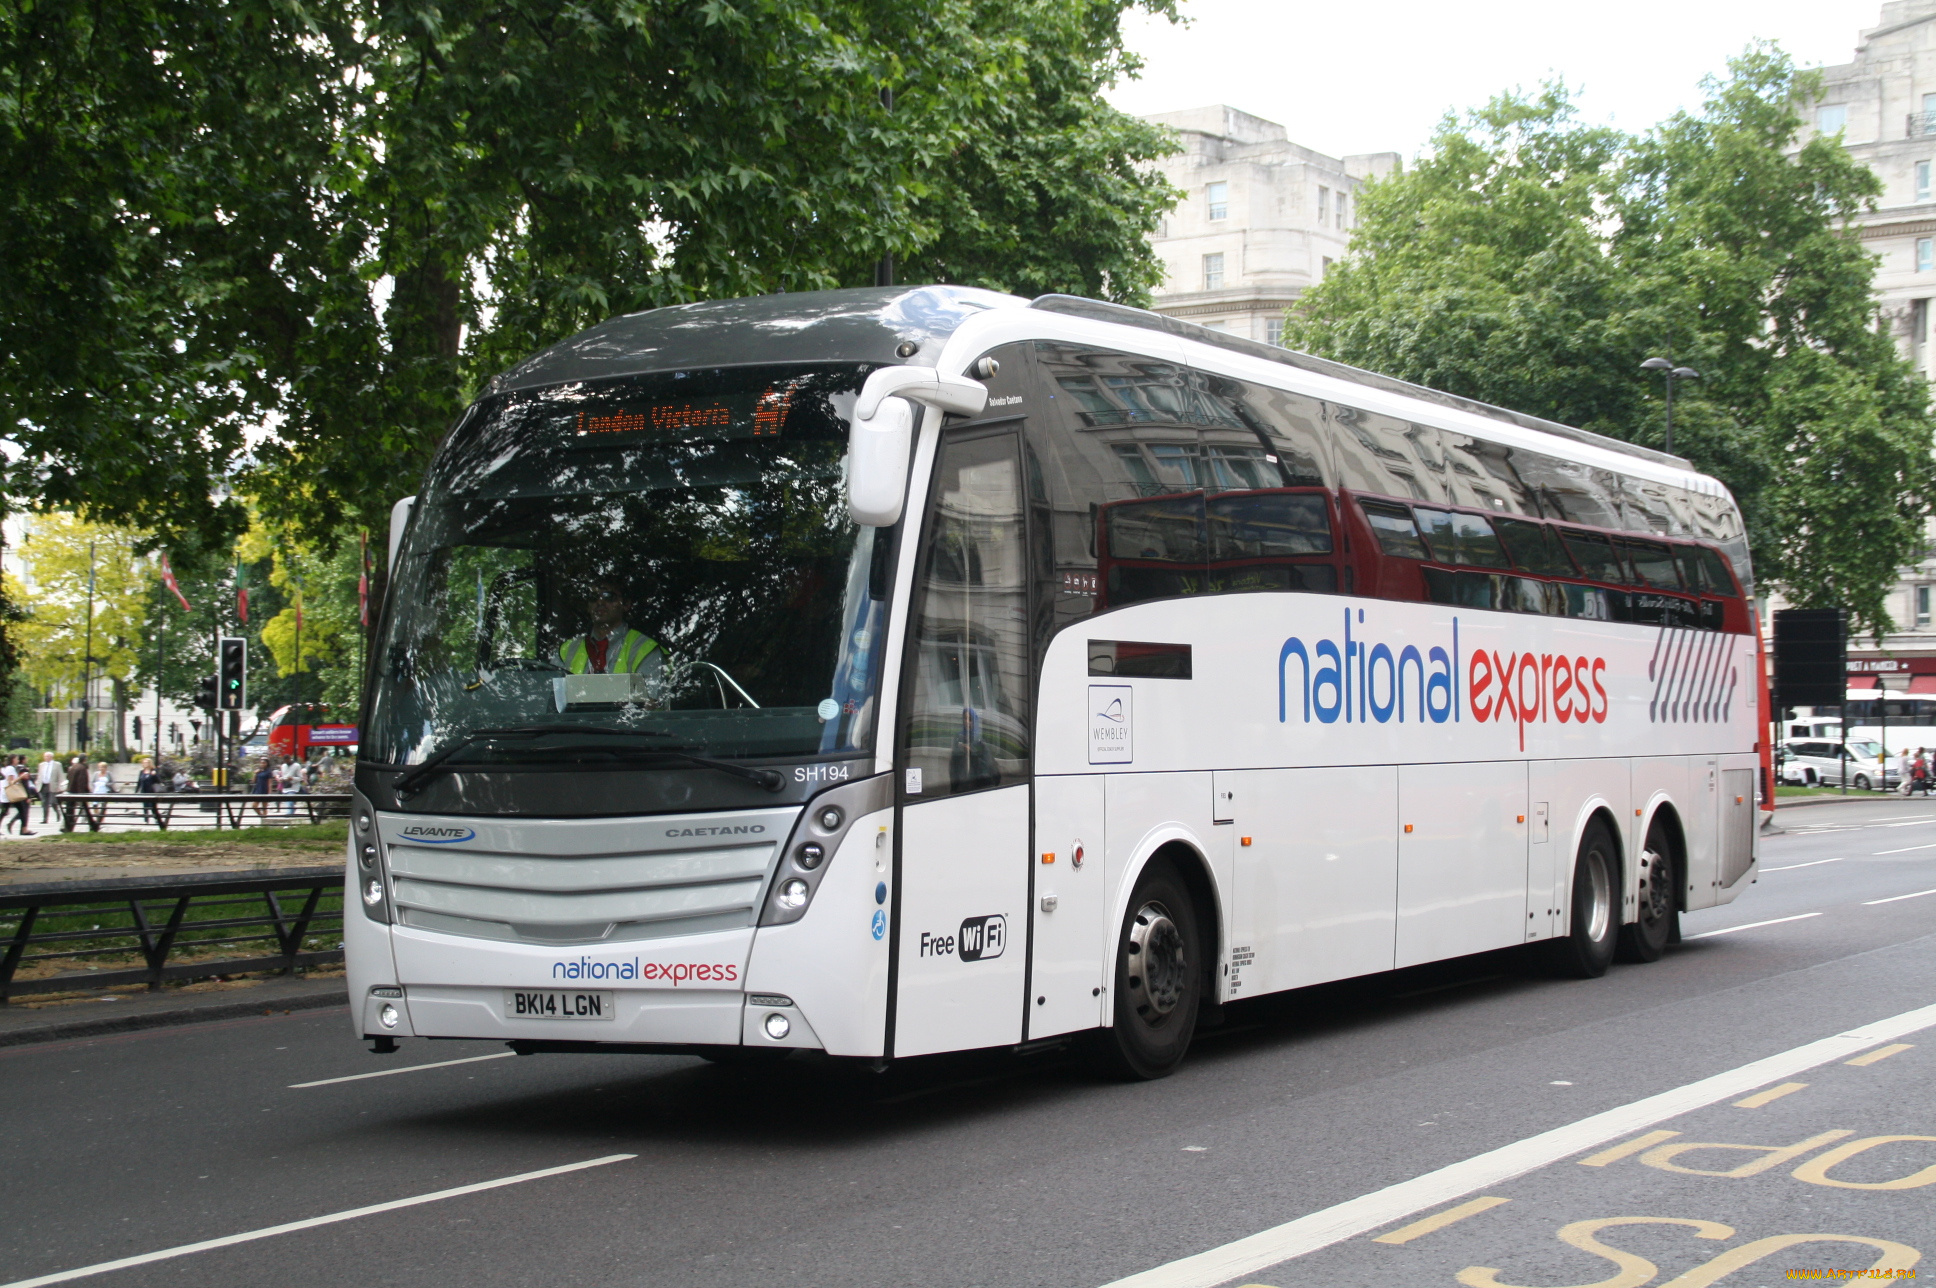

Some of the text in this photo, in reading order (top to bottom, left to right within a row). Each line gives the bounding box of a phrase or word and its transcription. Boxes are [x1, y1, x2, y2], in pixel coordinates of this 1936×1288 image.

[577, 409, 645, 433] London
[651, 402, 730, 429] Victoria
[1278, 607, 1608, 752] national express
[1093, 727, 1128, 740] WEMBLEY
[794, 766, 849, 782] SH194
[403, 826, 465, 838] LEVANTE
[665, 824, 766, 838] CAETANO
[920, 931, 955, 958] Free
[553, 956, 738, 987] national express
[515, 993, 602, 1016] BK14 LGN
